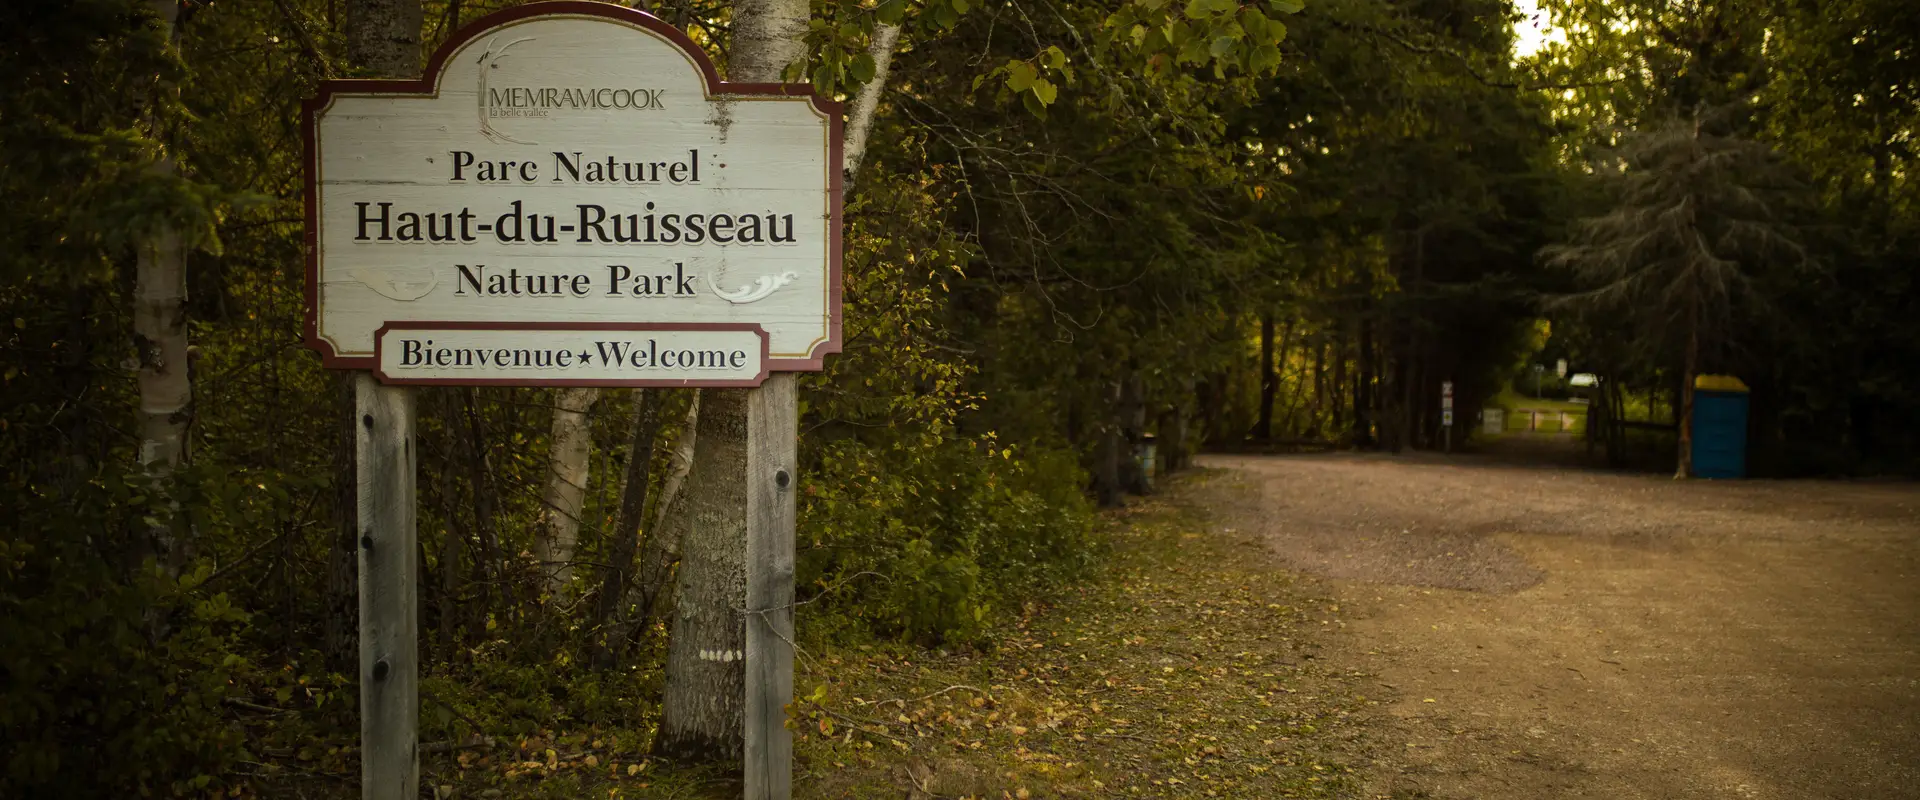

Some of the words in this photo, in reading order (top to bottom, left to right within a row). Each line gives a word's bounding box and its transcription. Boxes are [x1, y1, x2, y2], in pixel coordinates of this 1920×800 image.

[490, 87, 665, 110] MEMRAMCOOK
[490, 107, 498, 117] la
[500, 107, 521, 117] belle
[450, 150, 538, 182] Parc
[553, 149, 700, 183] Naturel
[353, 201, 796, 243] Haut-du-Ruisseau
[455, 264, 591, 296] Nature
[606, 262, 695, 296] Park
[400, 339, 572, 368] Bienvenue
[595, 341, 746, 369] Welcome
